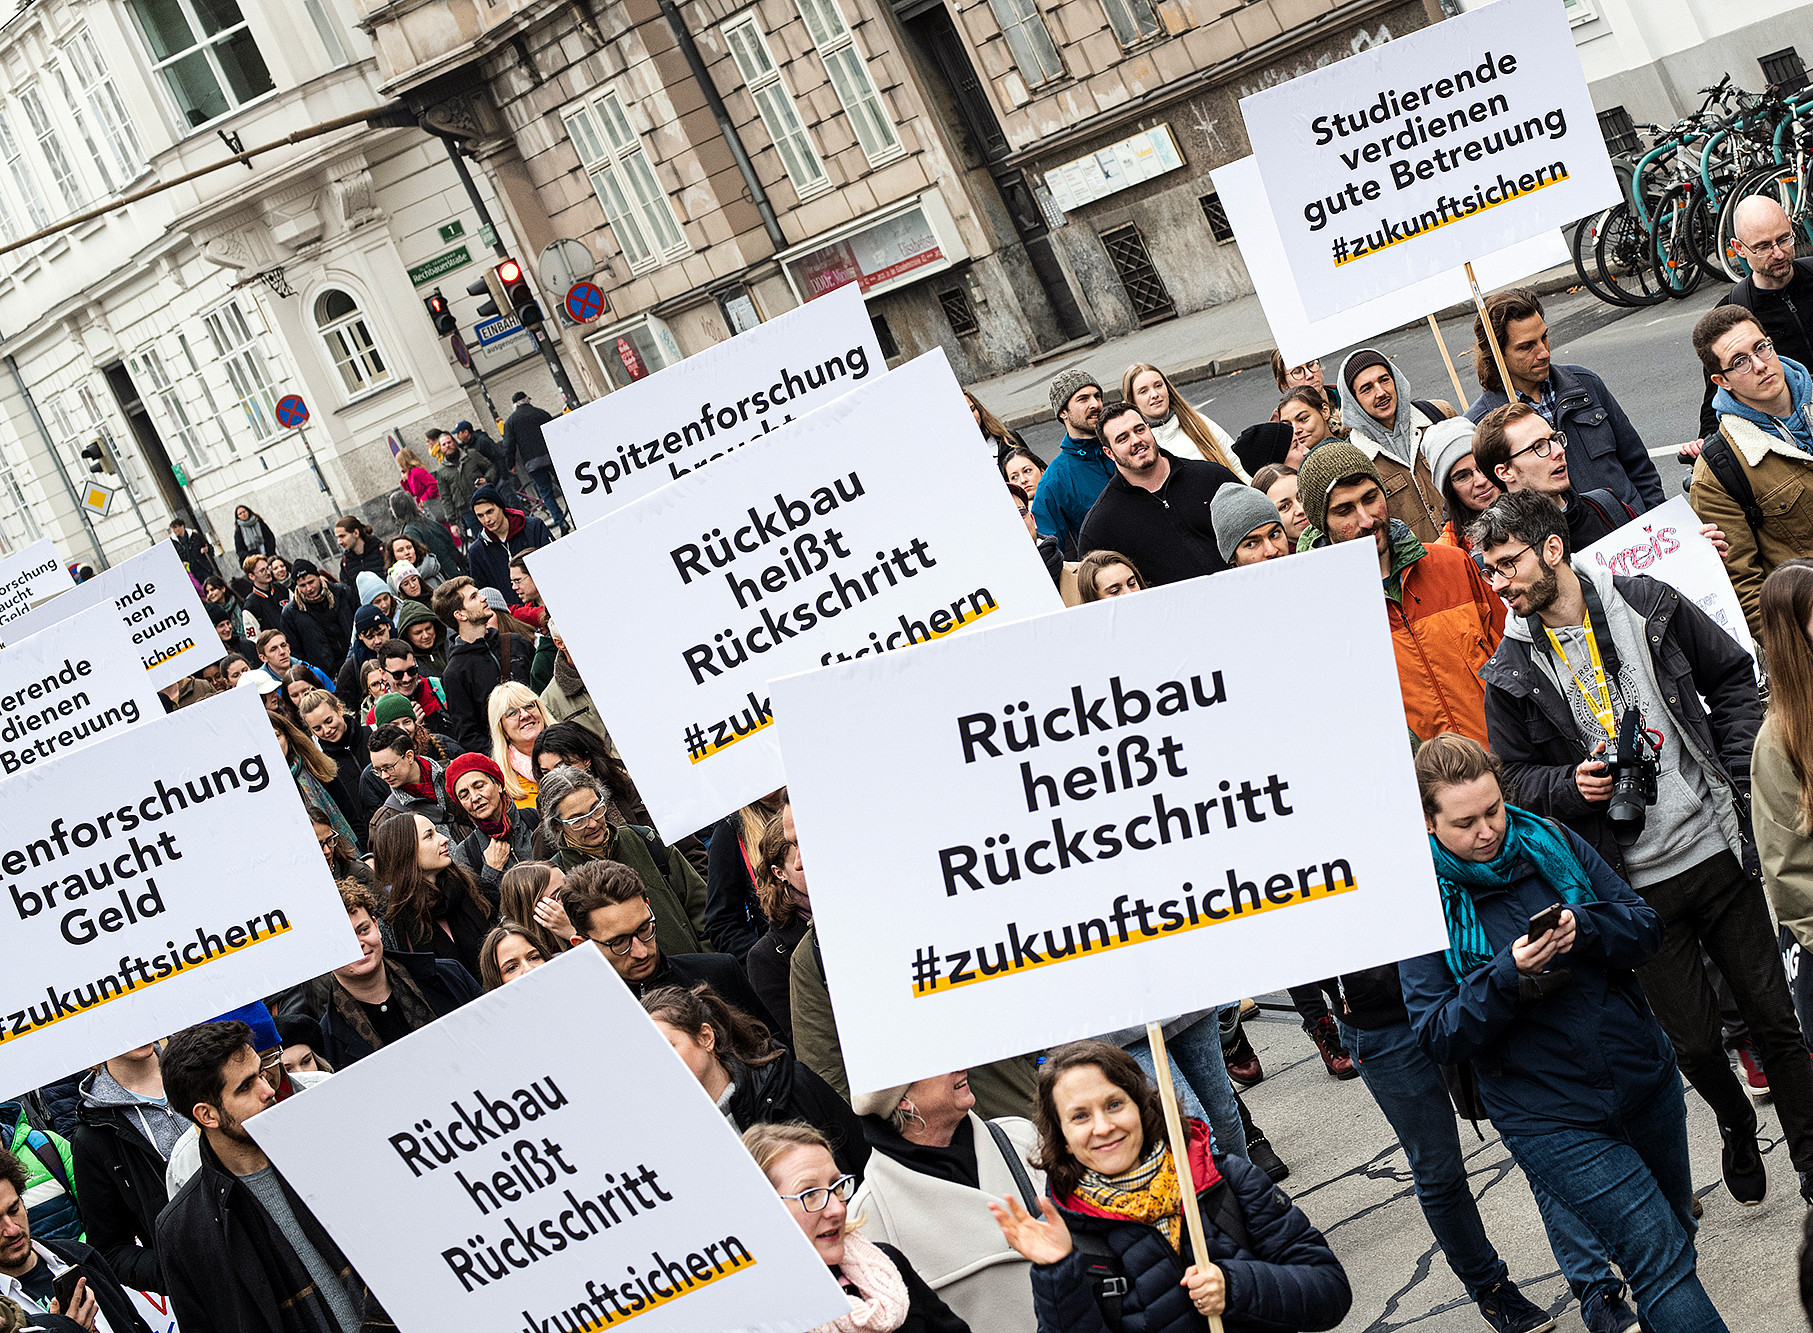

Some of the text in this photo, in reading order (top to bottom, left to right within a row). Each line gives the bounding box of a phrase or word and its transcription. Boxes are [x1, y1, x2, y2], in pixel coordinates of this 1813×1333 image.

[1311, 51, 1518, 146] Studierende
[1340, 93, 1510, 171] verdienen
[1303, 107, 1568, 232] gute Betreuung
[1331, 160, 1569, 265] #zukunftsichern
[412, 252, 468, 283] Rechbauerstraße
[447, 225, 455, 235] 1
[574, 345, 870, 495] Spitzenforschung
[669, 470, 866, 585] Rückbau
[724, 527, 851, 610] heißt
[115, 582, 156, 611] nde
[681, 537, 938, 686] Rückschritt
[0, 658, 93, 716] erende
[1, 691, 91, 743] dienen
[956, 669, 1228, 764] Rückbau
[0, 698, 140, 775] Betreuung
[1019, 734, 1189, 813] heißt
[0, 753, 270, 881] enforschung
[938, 774, 1294, 897] Rückschritt
[8, 830, 183, 921] braucht
[60, 877, 166, 946] Geld
[911, 857, 1356, 993] #zukunftsichern
[0, 908, 290, 1041] zukunftsichern
[387, 1075, 569, 1178] Rückbau
[454, 1137, 578, 1216] heißt
[440, 1163, 674, 1293] Rückschritt
[514, 1235, 753, 1333] kunftsichern
